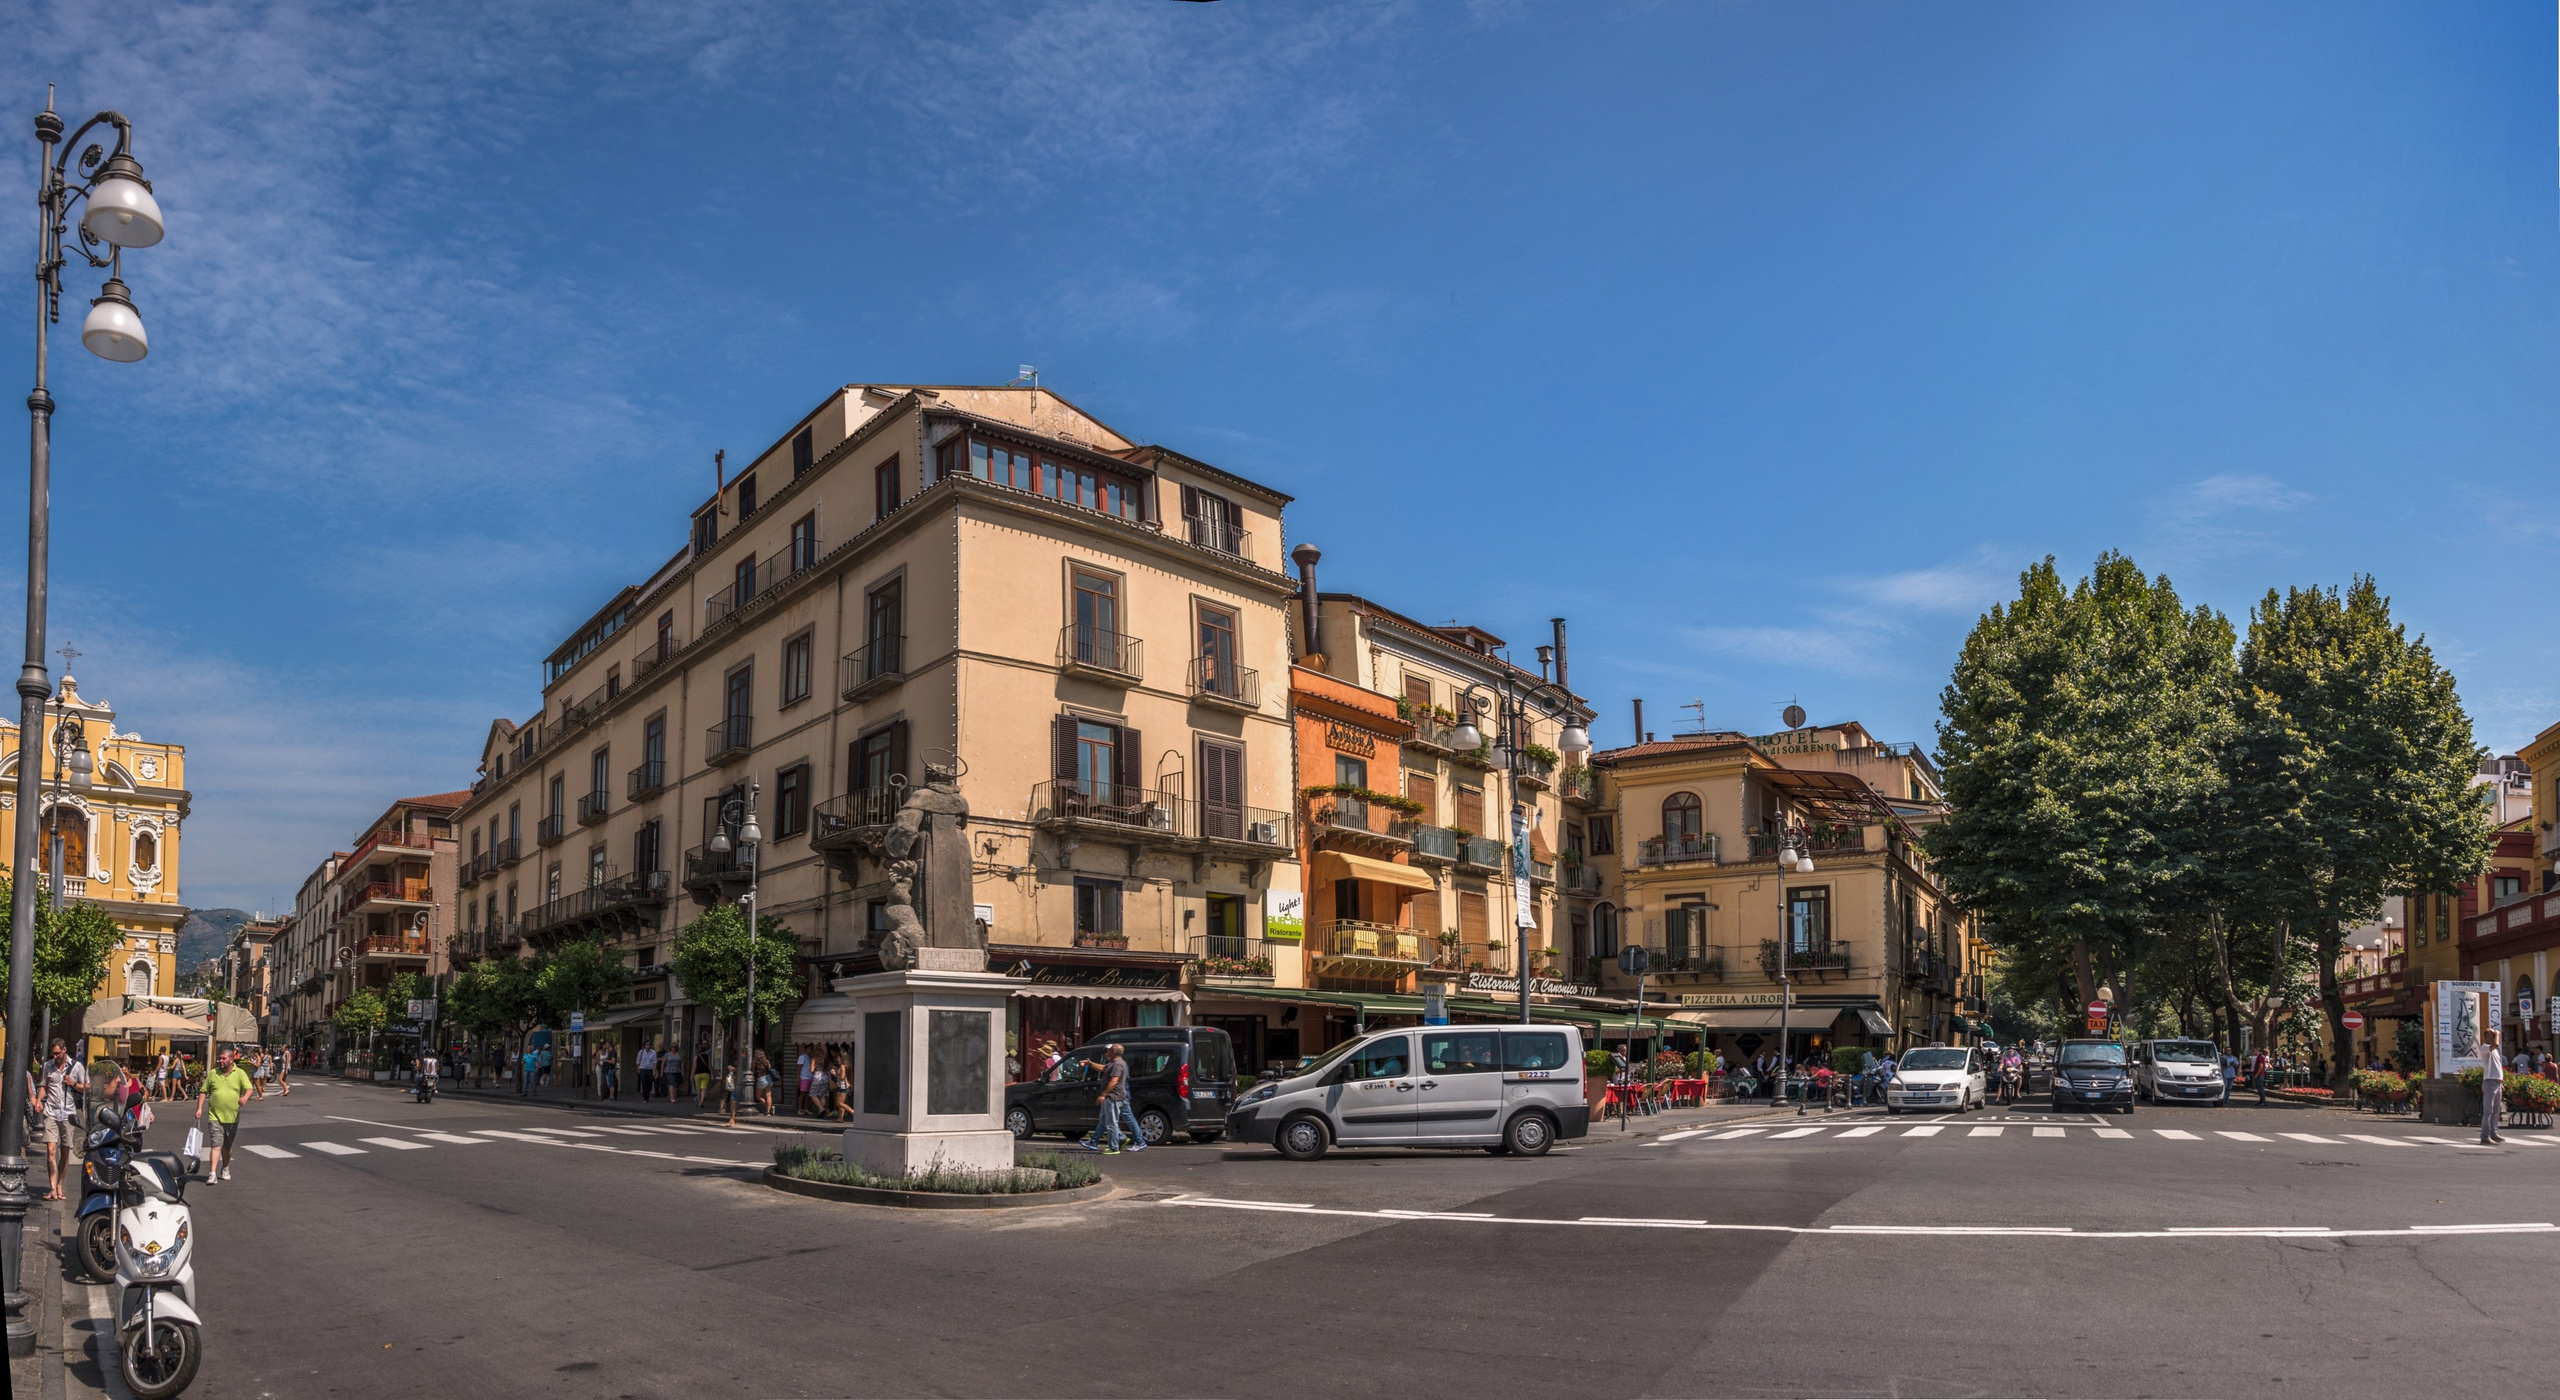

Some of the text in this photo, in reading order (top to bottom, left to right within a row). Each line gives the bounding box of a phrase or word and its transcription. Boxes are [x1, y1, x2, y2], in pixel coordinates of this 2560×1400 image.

[1328, 720, 1376, 749] AURORA
[1755, 730, 1819, 747] HOTEL
[1782, 743, 1838, 754] SORRENTO
[1279, 896, 1301, 917] light!
[1269, 927, 1302, 937] Ristorante
[921, 951, 983, 961] FIDELITATIS
[1088, 967, 1169, 988] Branch
[1469, 972, 1522, 991] Ristorant
[1541, 979, 1578, 995] Canonico
[1684, 995, 1736, 1004] PIZZERIA
[156, 1003, 184, 1015] BAR
[2490, 994, 2500, 1029] PICA
[2089, 1020, 2106, 1028] TAXI
